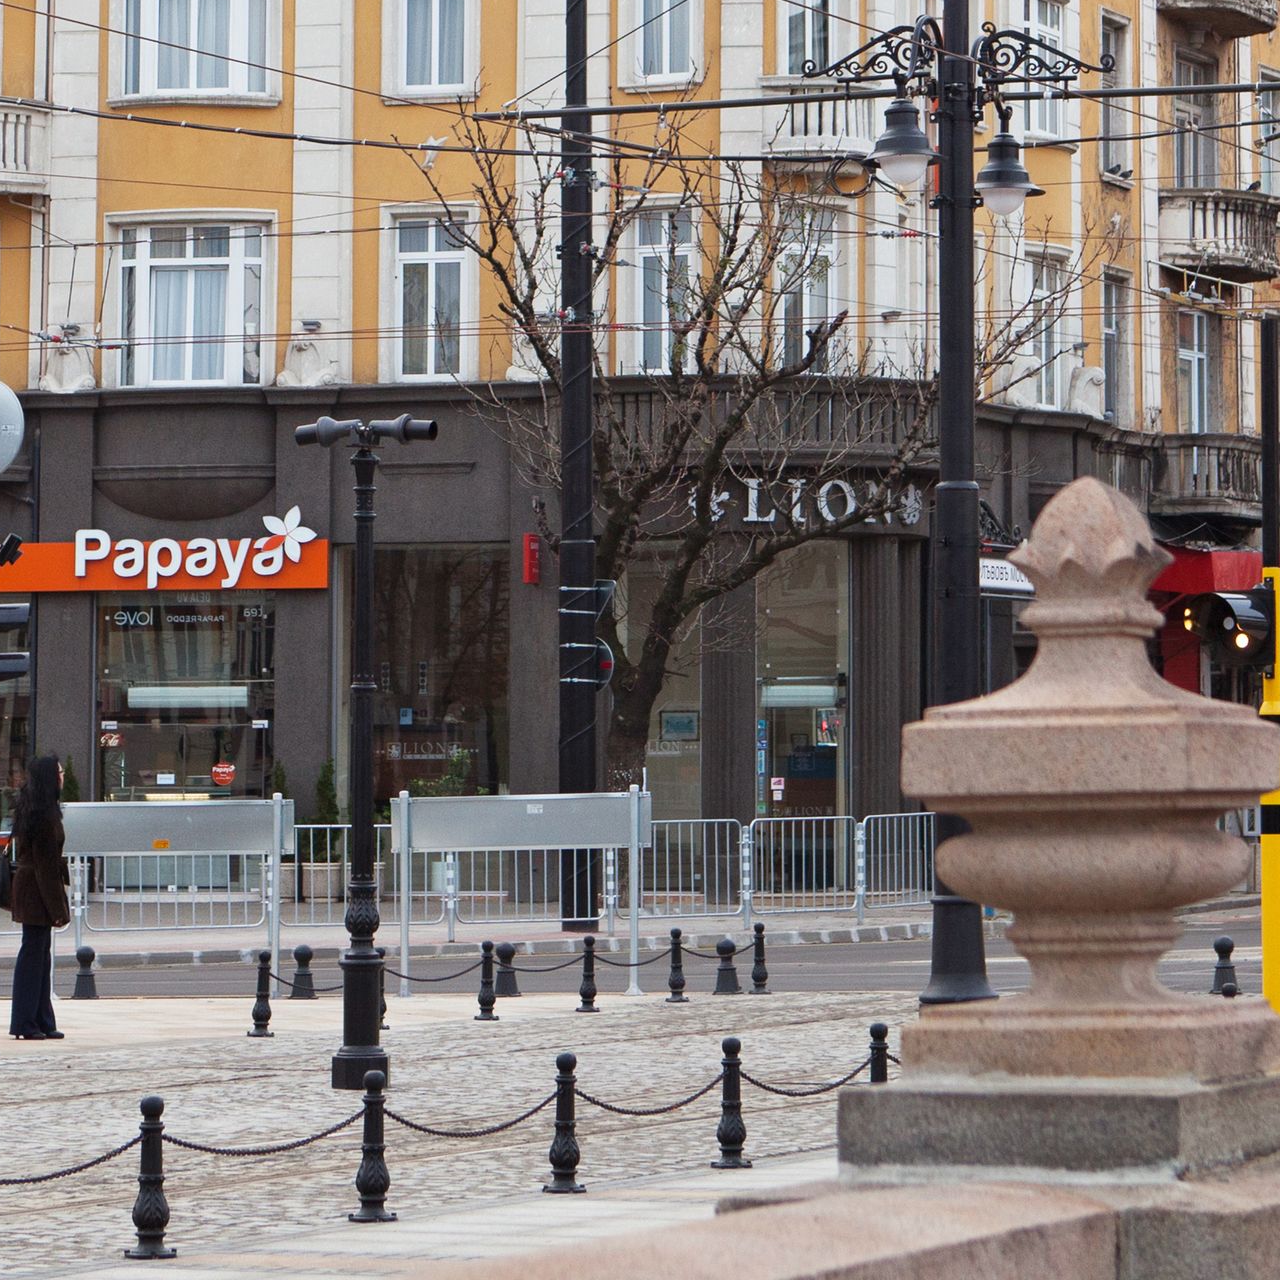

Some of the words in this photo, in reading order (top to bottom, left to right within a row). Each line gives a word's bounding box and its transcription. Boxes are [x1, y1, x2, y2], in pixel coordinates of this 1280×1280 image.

[742, 478, 891, 524] LION
[75, 529, 284, 589] Papaya
[403, 742, 446, 754] LION
